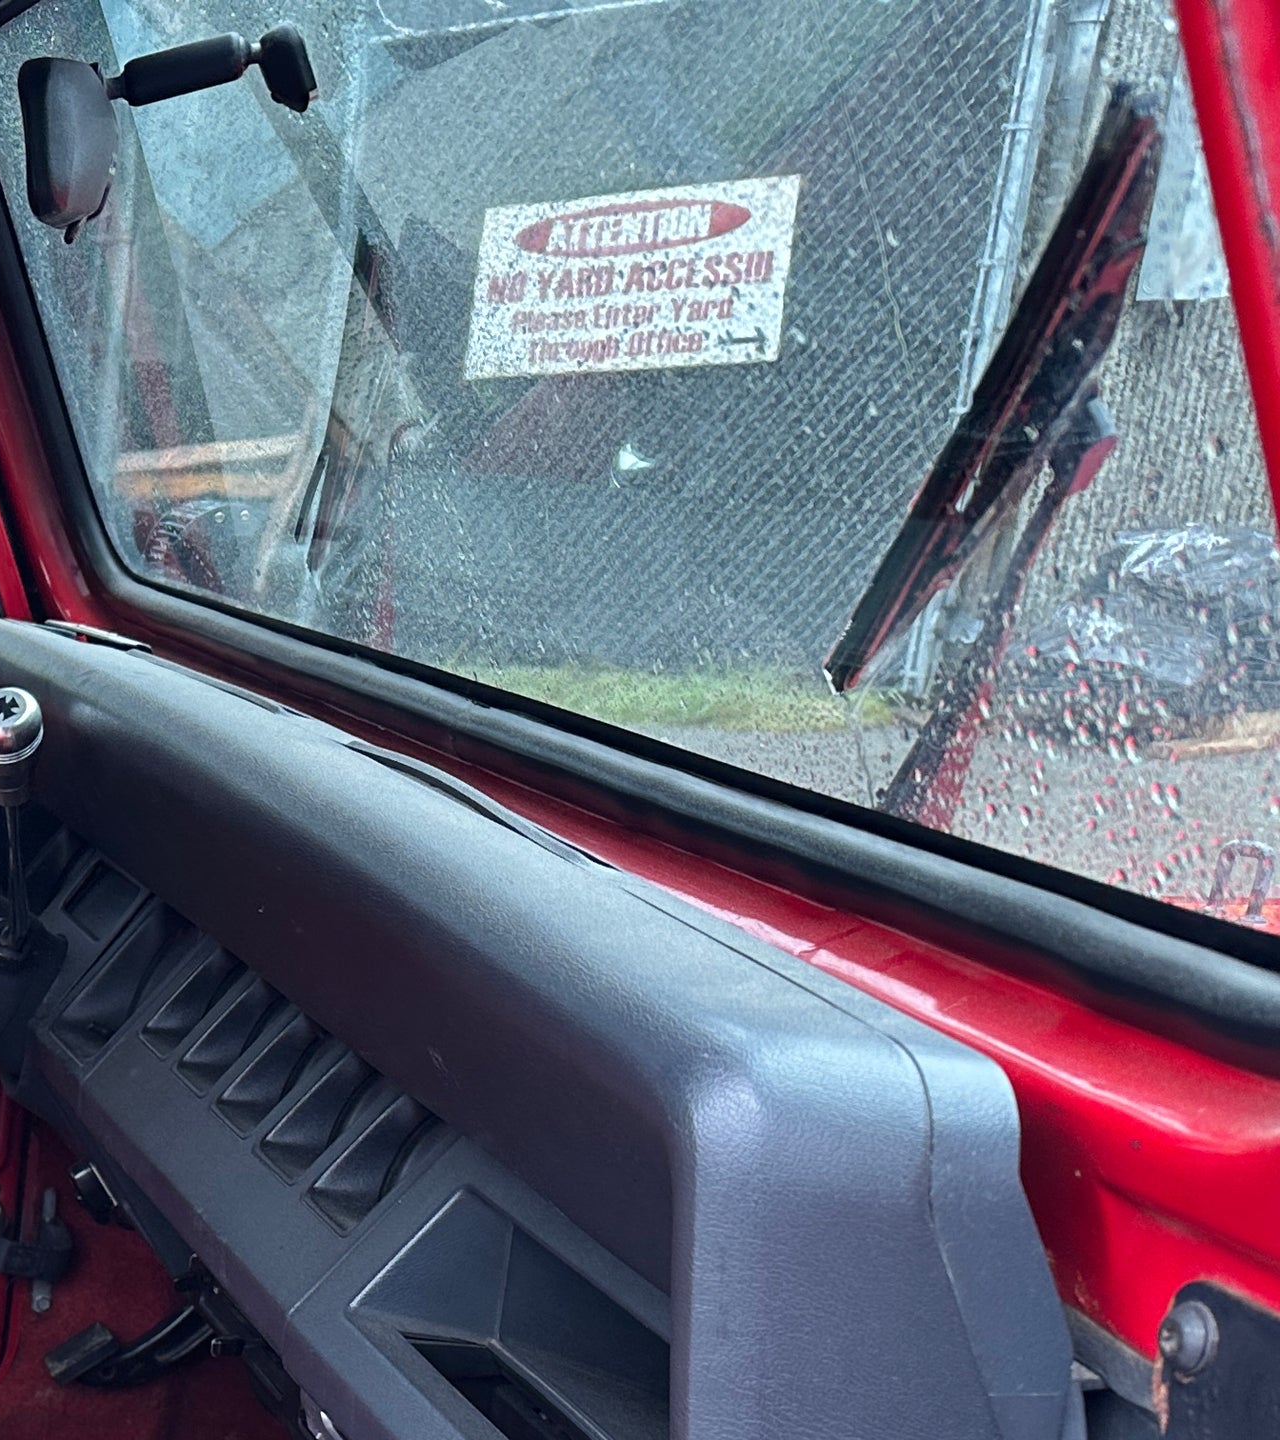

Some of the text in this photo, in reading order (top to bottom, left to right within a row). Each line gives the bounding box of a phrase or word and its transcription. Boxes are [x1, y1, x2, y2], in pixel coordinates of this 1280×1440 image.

[545, 203, 712, 252] ATTENTION
[487, 250, 774, 304] NO YARD ACCESS!!!
[511, 296, 735, 334] Please Enter Yard
[628, 331, 703, 357] Office
